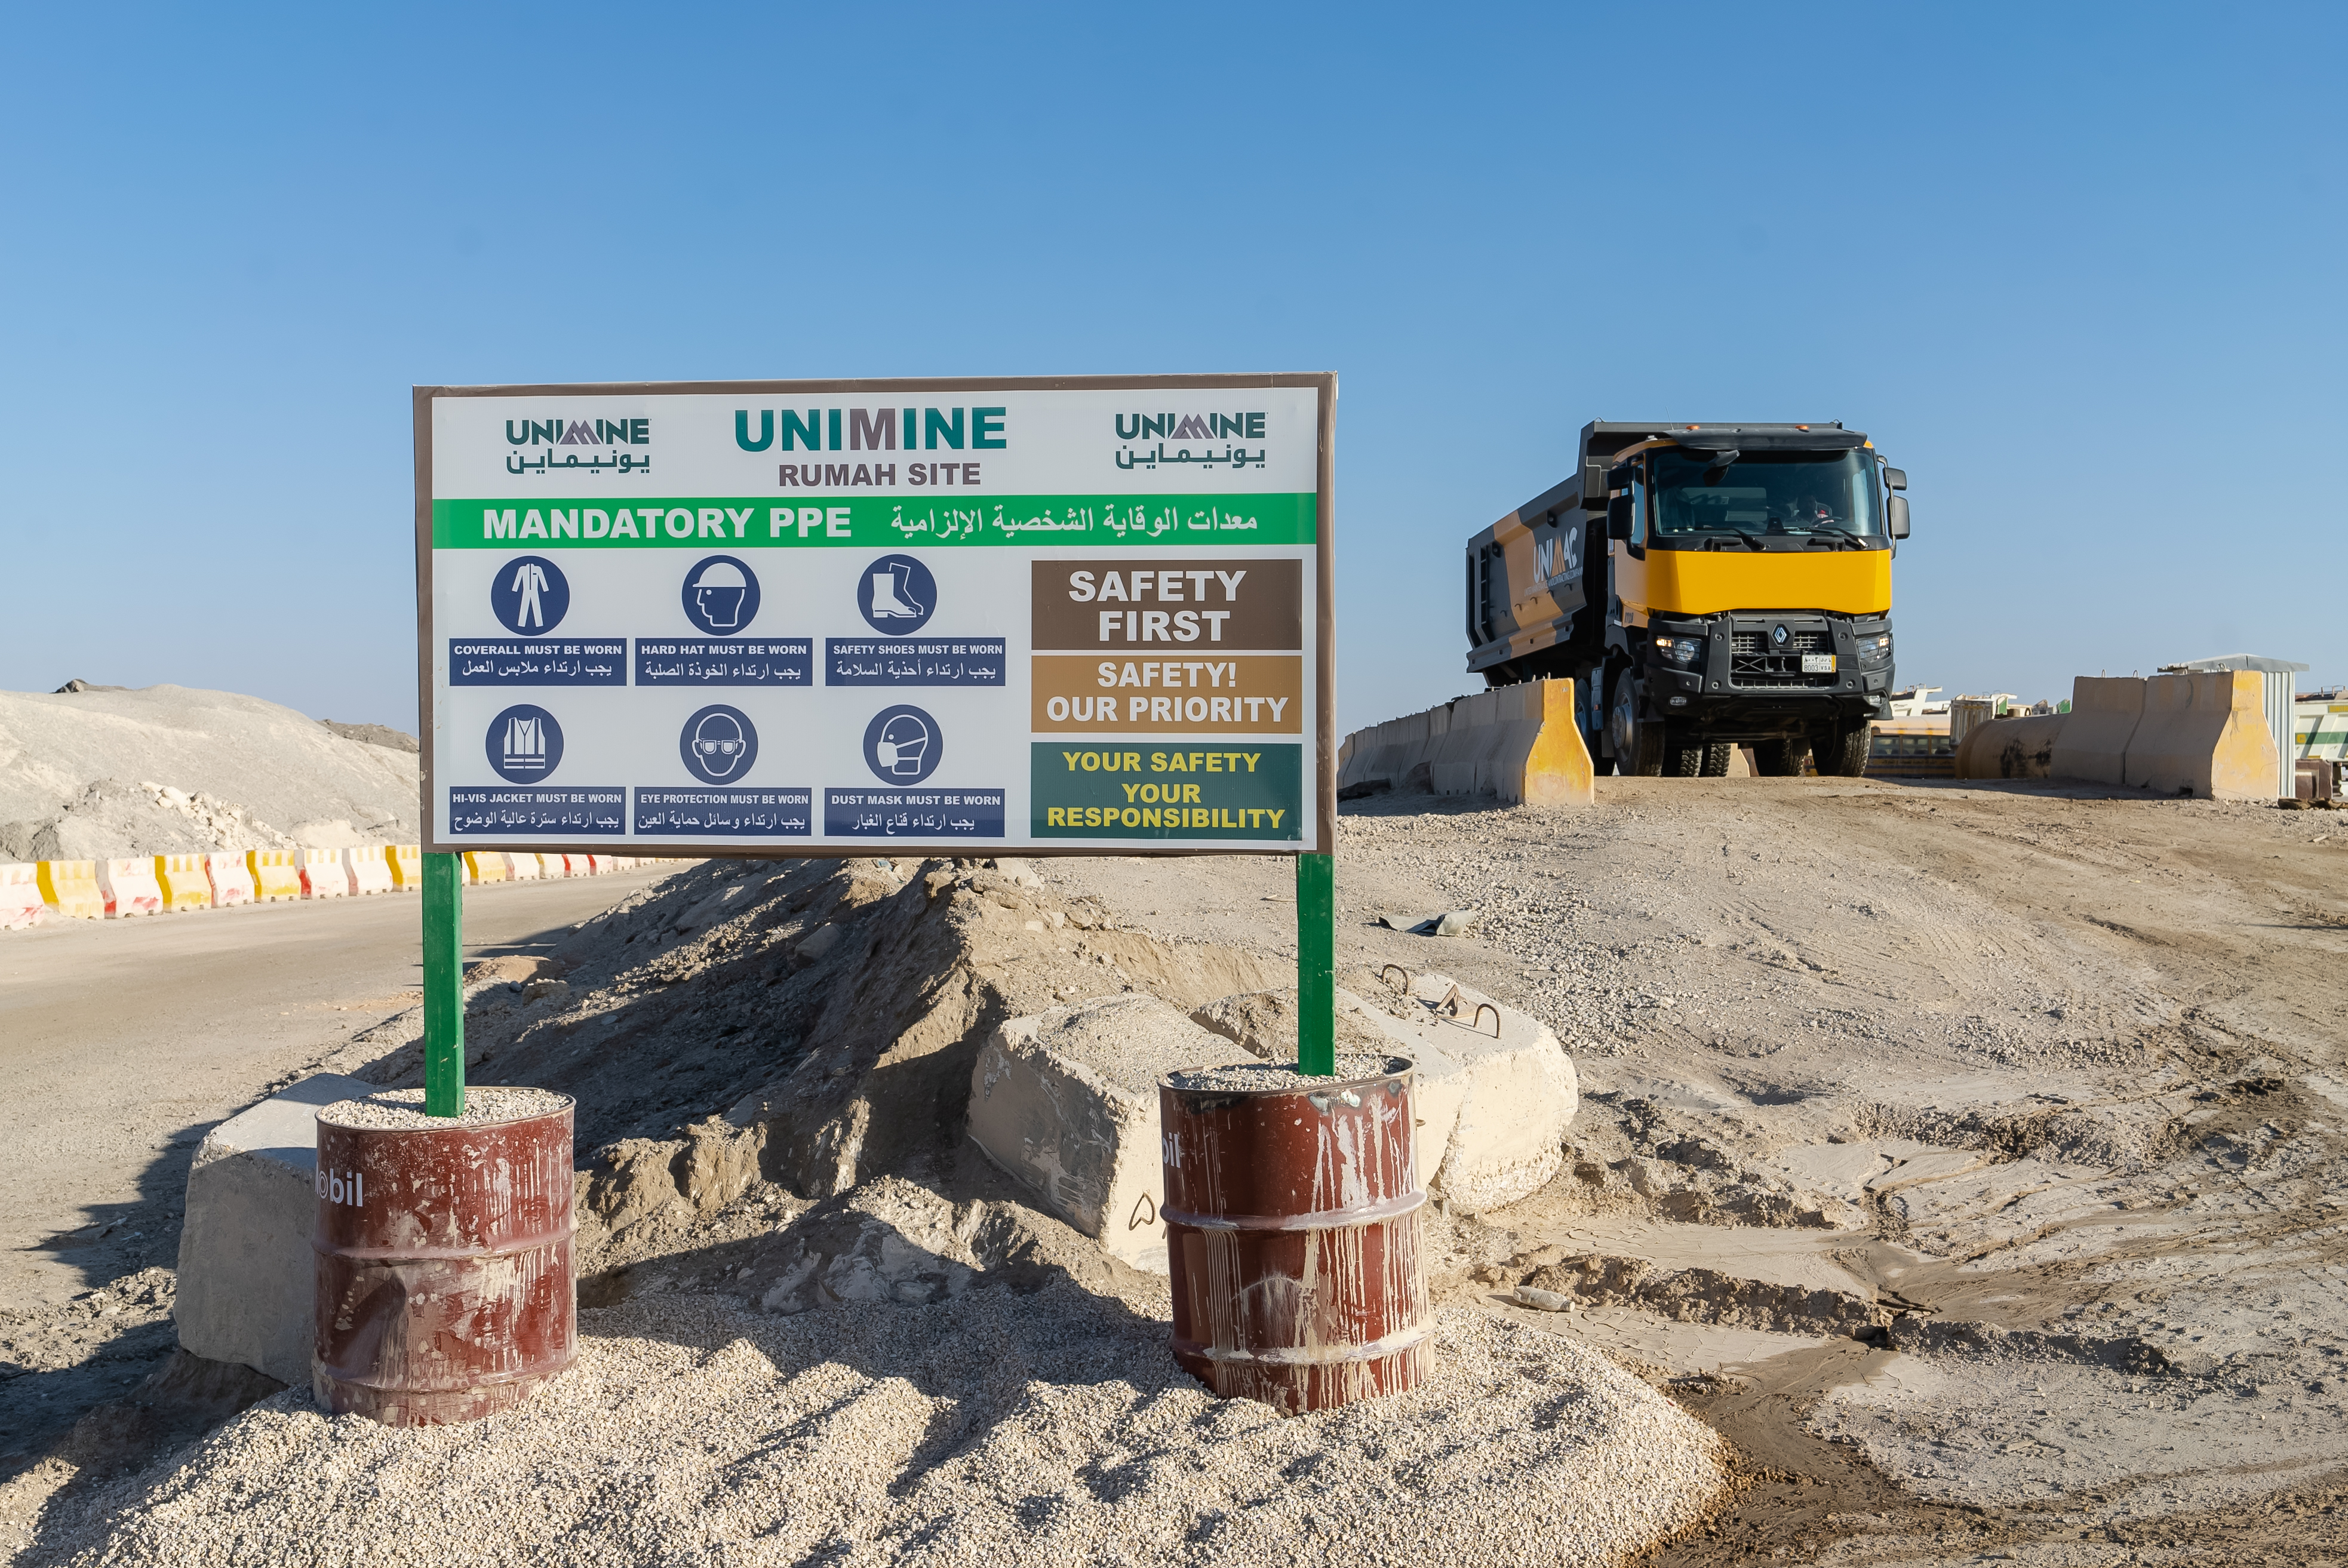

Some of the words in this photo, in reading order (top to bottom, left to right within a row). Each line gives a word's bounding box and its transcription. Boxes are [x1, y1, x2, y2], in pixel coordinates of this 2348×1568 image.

[506, 419, 649, 445] UNIMINE
[735, 407, 1006, 452] UNIMINE
[1116, 413, 1265, 439] UNIMINE
[507, 448, 650, 474] يونيماين
[1116, 443, 1265, 469] يونيماين
[779, 464, 895, 486] RUMAH
[908, 463, 981, 485] SITE
[484, 508, 754, 539] MANDATORY
[770, 508, 851, 537] PPE
[892, 505, 982, 540] الإلزامية
[992, 505, 1093, 538] الشخصية
[1104, 504, 1178, 537] الوقاية
[1188, 506, 1257, 530] معدات
[1533, 527, 1577, 583] UNIMAC
[1069, 571, 1246, 601] SAFETY
[1099, 611, 1230, 641] FIRST
[454, 646, 521, 654] COVERALL
[525, 645, 560, 654] MUST
[564, 645, 580, 654] BE
[584, 645, 621, 654] WORN
[642, 645, 676, 654] HARD
[681, 645, 705, 654] HAT
[709, 645, 744, 654] MUST
[749, 645, 764, 654] BE
[769, 645, 806, 654] WORN
[834, 645, 875, 654] SAFETY
[878, 645, 915, 654] SHOES
[918, 645, 949, 654] MUST
[952, 645, 966, 654] BE
[970, 645, 1002, 654] WORN
[463, 660, 493, 675] العمل
[499, 661, 538, 676] ملابس
[545, 660, 580, 676] ارتداء
[585, 665, 611, 676] يجب
[646, 662, 683, 679] الصلبة
[689, 662, 727, 679] الخوذة
[733, 663, 769, 680] ارتداء
[775, 669, 800, 680] يجب
[837, 661, 882, 676] السلامة
[888, 659, 921, 679] أحذية
[927, 662, 963, 679] ارتداء
[969, 668, 995, 679] يجب
[1098, 662, 1236, 687] SAFETY!
[1047, 696, 1118, 721] OUR
[1130, 697, 1288, 721] PRIORITY
[1062, 752, 1141, 771] YOUR
[1151, 752, 1261, 771] SAFETY
[453, 794, 486, 803] HI-VIS
[490, 794, 533, 803] JACKET
[537, 794, 567, 803] MUST
[571, 794, 585, 803] BE
[588, 794, 621, 803] WORN
[663, 795, 727, 803] PROTECTION
[731, 795, 759, 804] MUST
[763, 795, 775, 804] BE
[778, 795, 808, 804] WORN
[832, 795, 863, 804] DUST
[868, 796, 902, 804] MASK
[906, 796, 941, 804] MUST
[945, 796, 960, 804] BE
[964, 796, 1000, 805] WORN
[1122, 784, 1201, 803] YOUR
[455, 811, 496, 831] الوضوح
[501, 810, 526, 828] عالية
[531, 811, 556, 828] سترة
[562, 811, 592, 828] ارتداء
[597, 817, 619, 828] يجب
[639, 812, 665, 828] العين
[669, 810, 699, 828] حماية
[704, 813, 739, 829] وسائل
[745, 813, 776, 829] ارتداء
[781, 818, 804, 829] يجب
[852, 814, 881, 829] الغبار
[887, 813, 907, 834] قناع
[913, 814, 945, 830] ارتداء
[951, 819, 974, 830] يجب
[1048, 807, 1285, 828] RESPONSIBILITY
